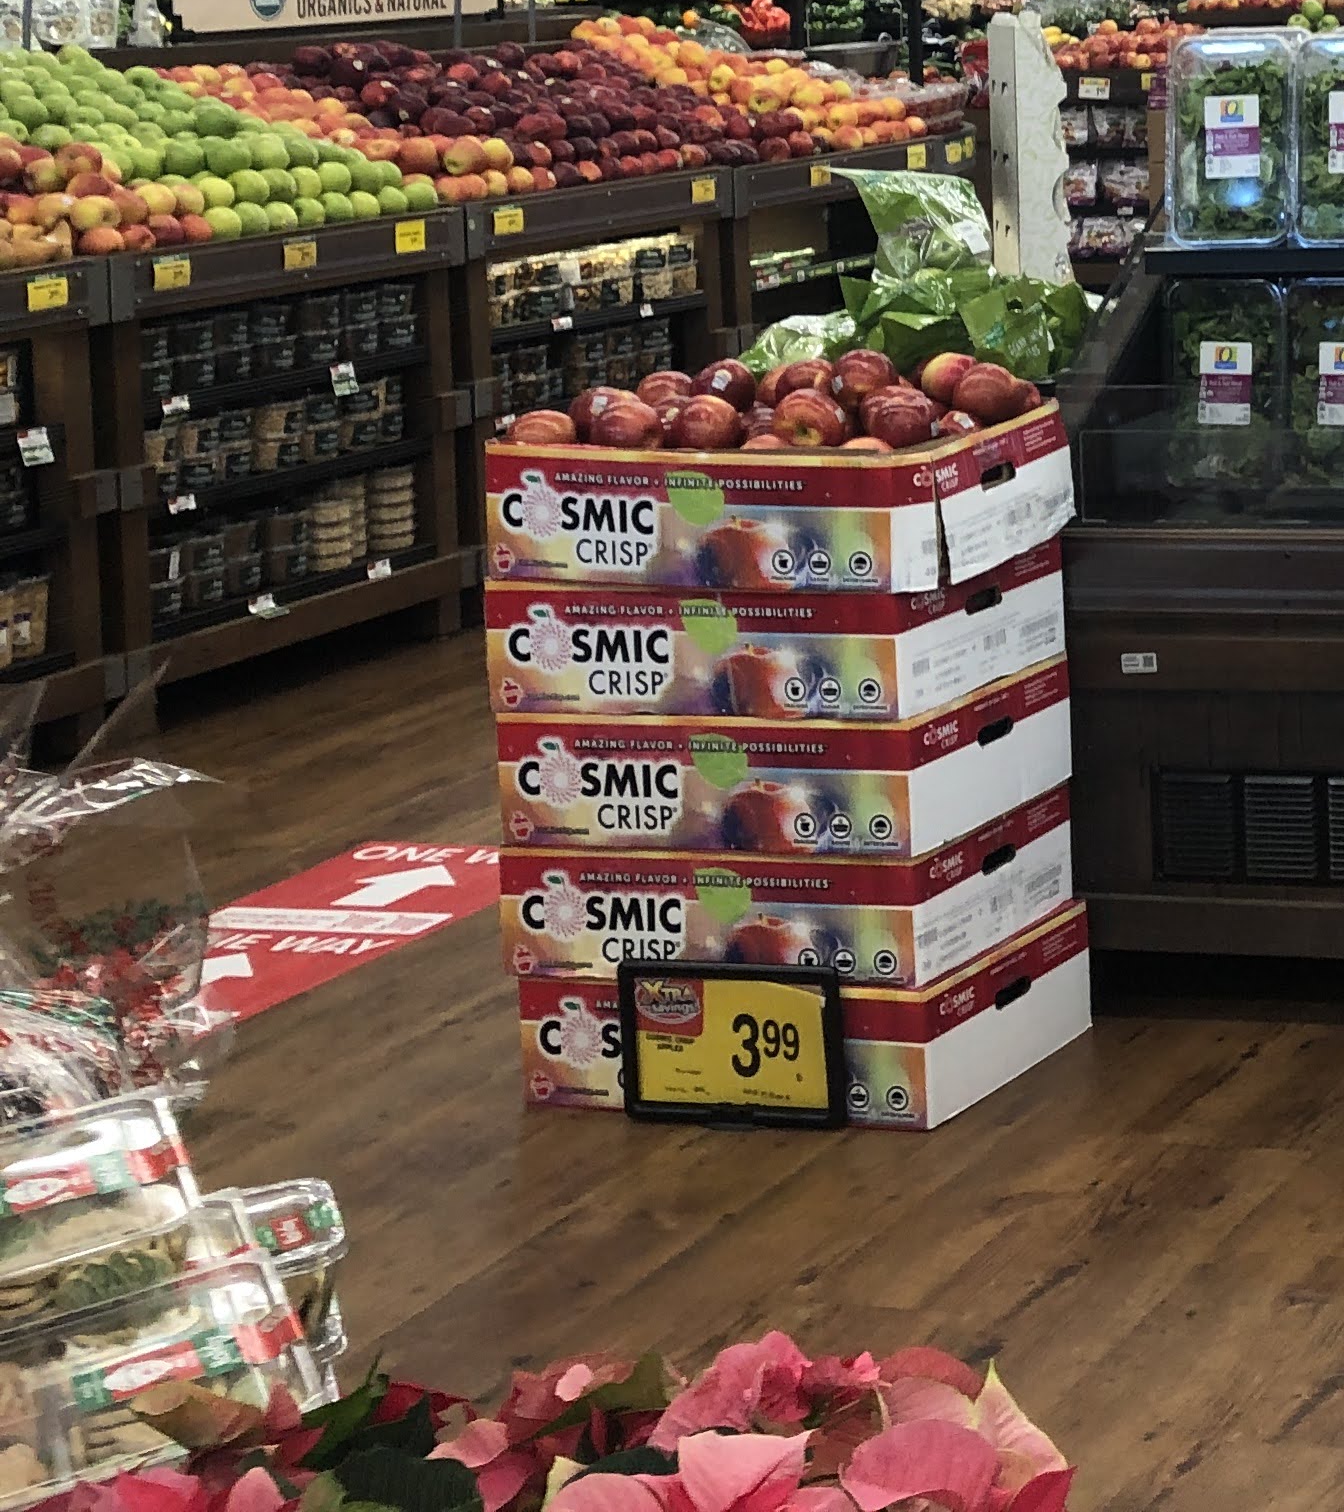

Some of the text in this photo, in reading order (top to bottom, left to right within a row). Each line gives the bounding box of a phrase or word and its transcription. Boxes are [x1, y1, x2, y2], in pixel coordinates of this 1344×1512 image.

[555, 472, 803, 490] AMAZING FLAVOR INFINITE POSSIBILITIES
[576, 538, 649, 565] CRISP
[564, 605, 813, 619] AMAZING FLAVOR INFINITE POSSIBILITIES
[588, 670, 664, 695] CRISP
[574, 739, 825, 754] AMAZING FLAVOR INFINITE POSSIBILITIES
[598, 803, 673, 830] CRISP
[353, 845, 465, 863] ONE
[579, 872, 830, 889] AMAZING FLAVOR INFINITE POSSIBILITIES
[270, 935, 396, 955] WAY
[602, 938, 677, 962] CRISP
